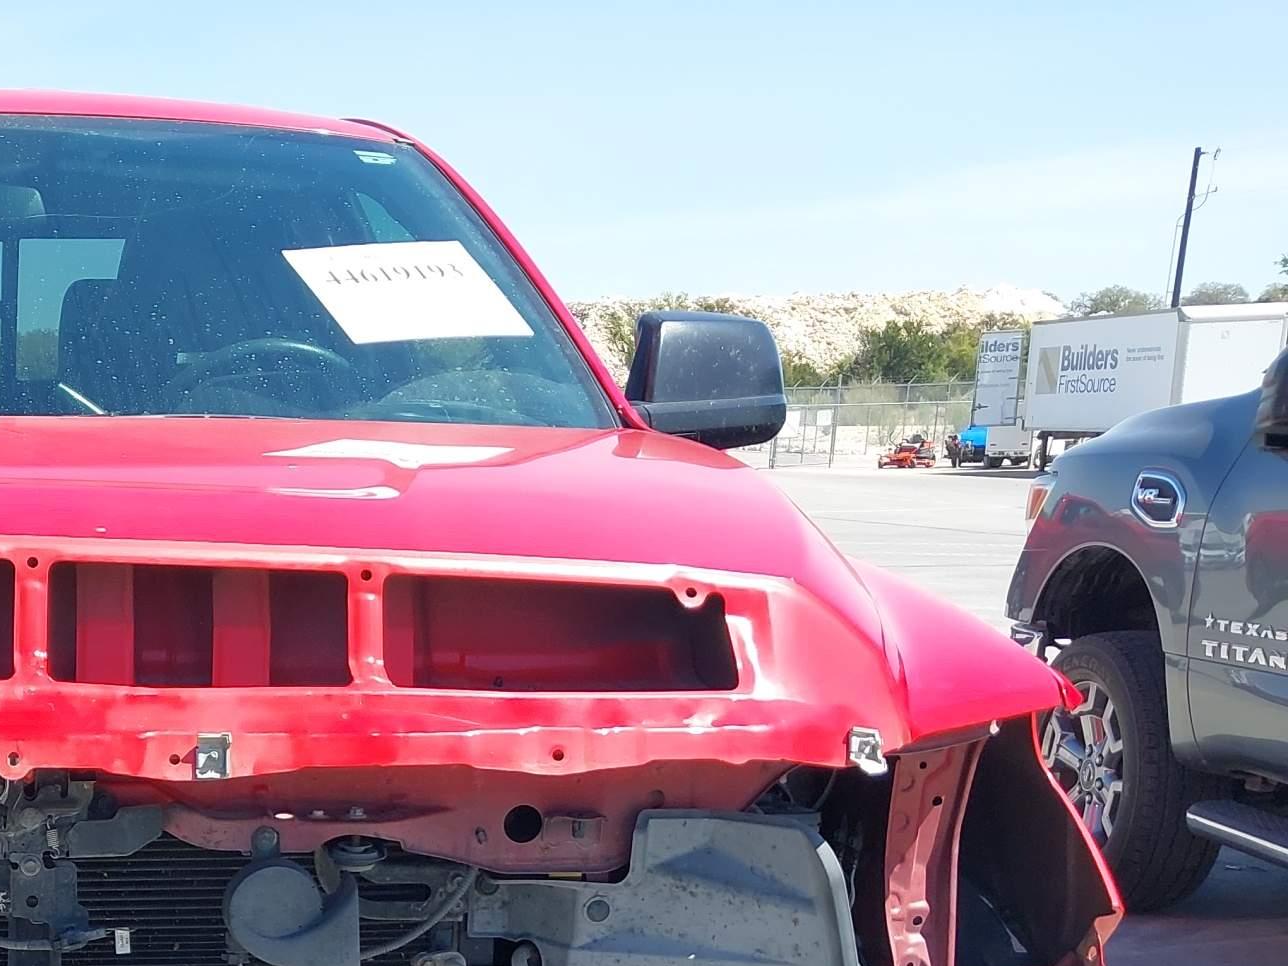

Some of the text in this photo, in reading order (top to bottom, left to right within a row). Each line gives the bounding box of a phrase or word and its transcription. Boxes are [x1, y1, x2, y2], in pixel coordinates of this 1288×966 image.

[1060, 343, 1119, 372] Builders
[1057, 373, 1117, 394] FirstSource
[1216, 618, 1288, 641] TEXAS
[1201, 639, 1287, 670] TITAN
